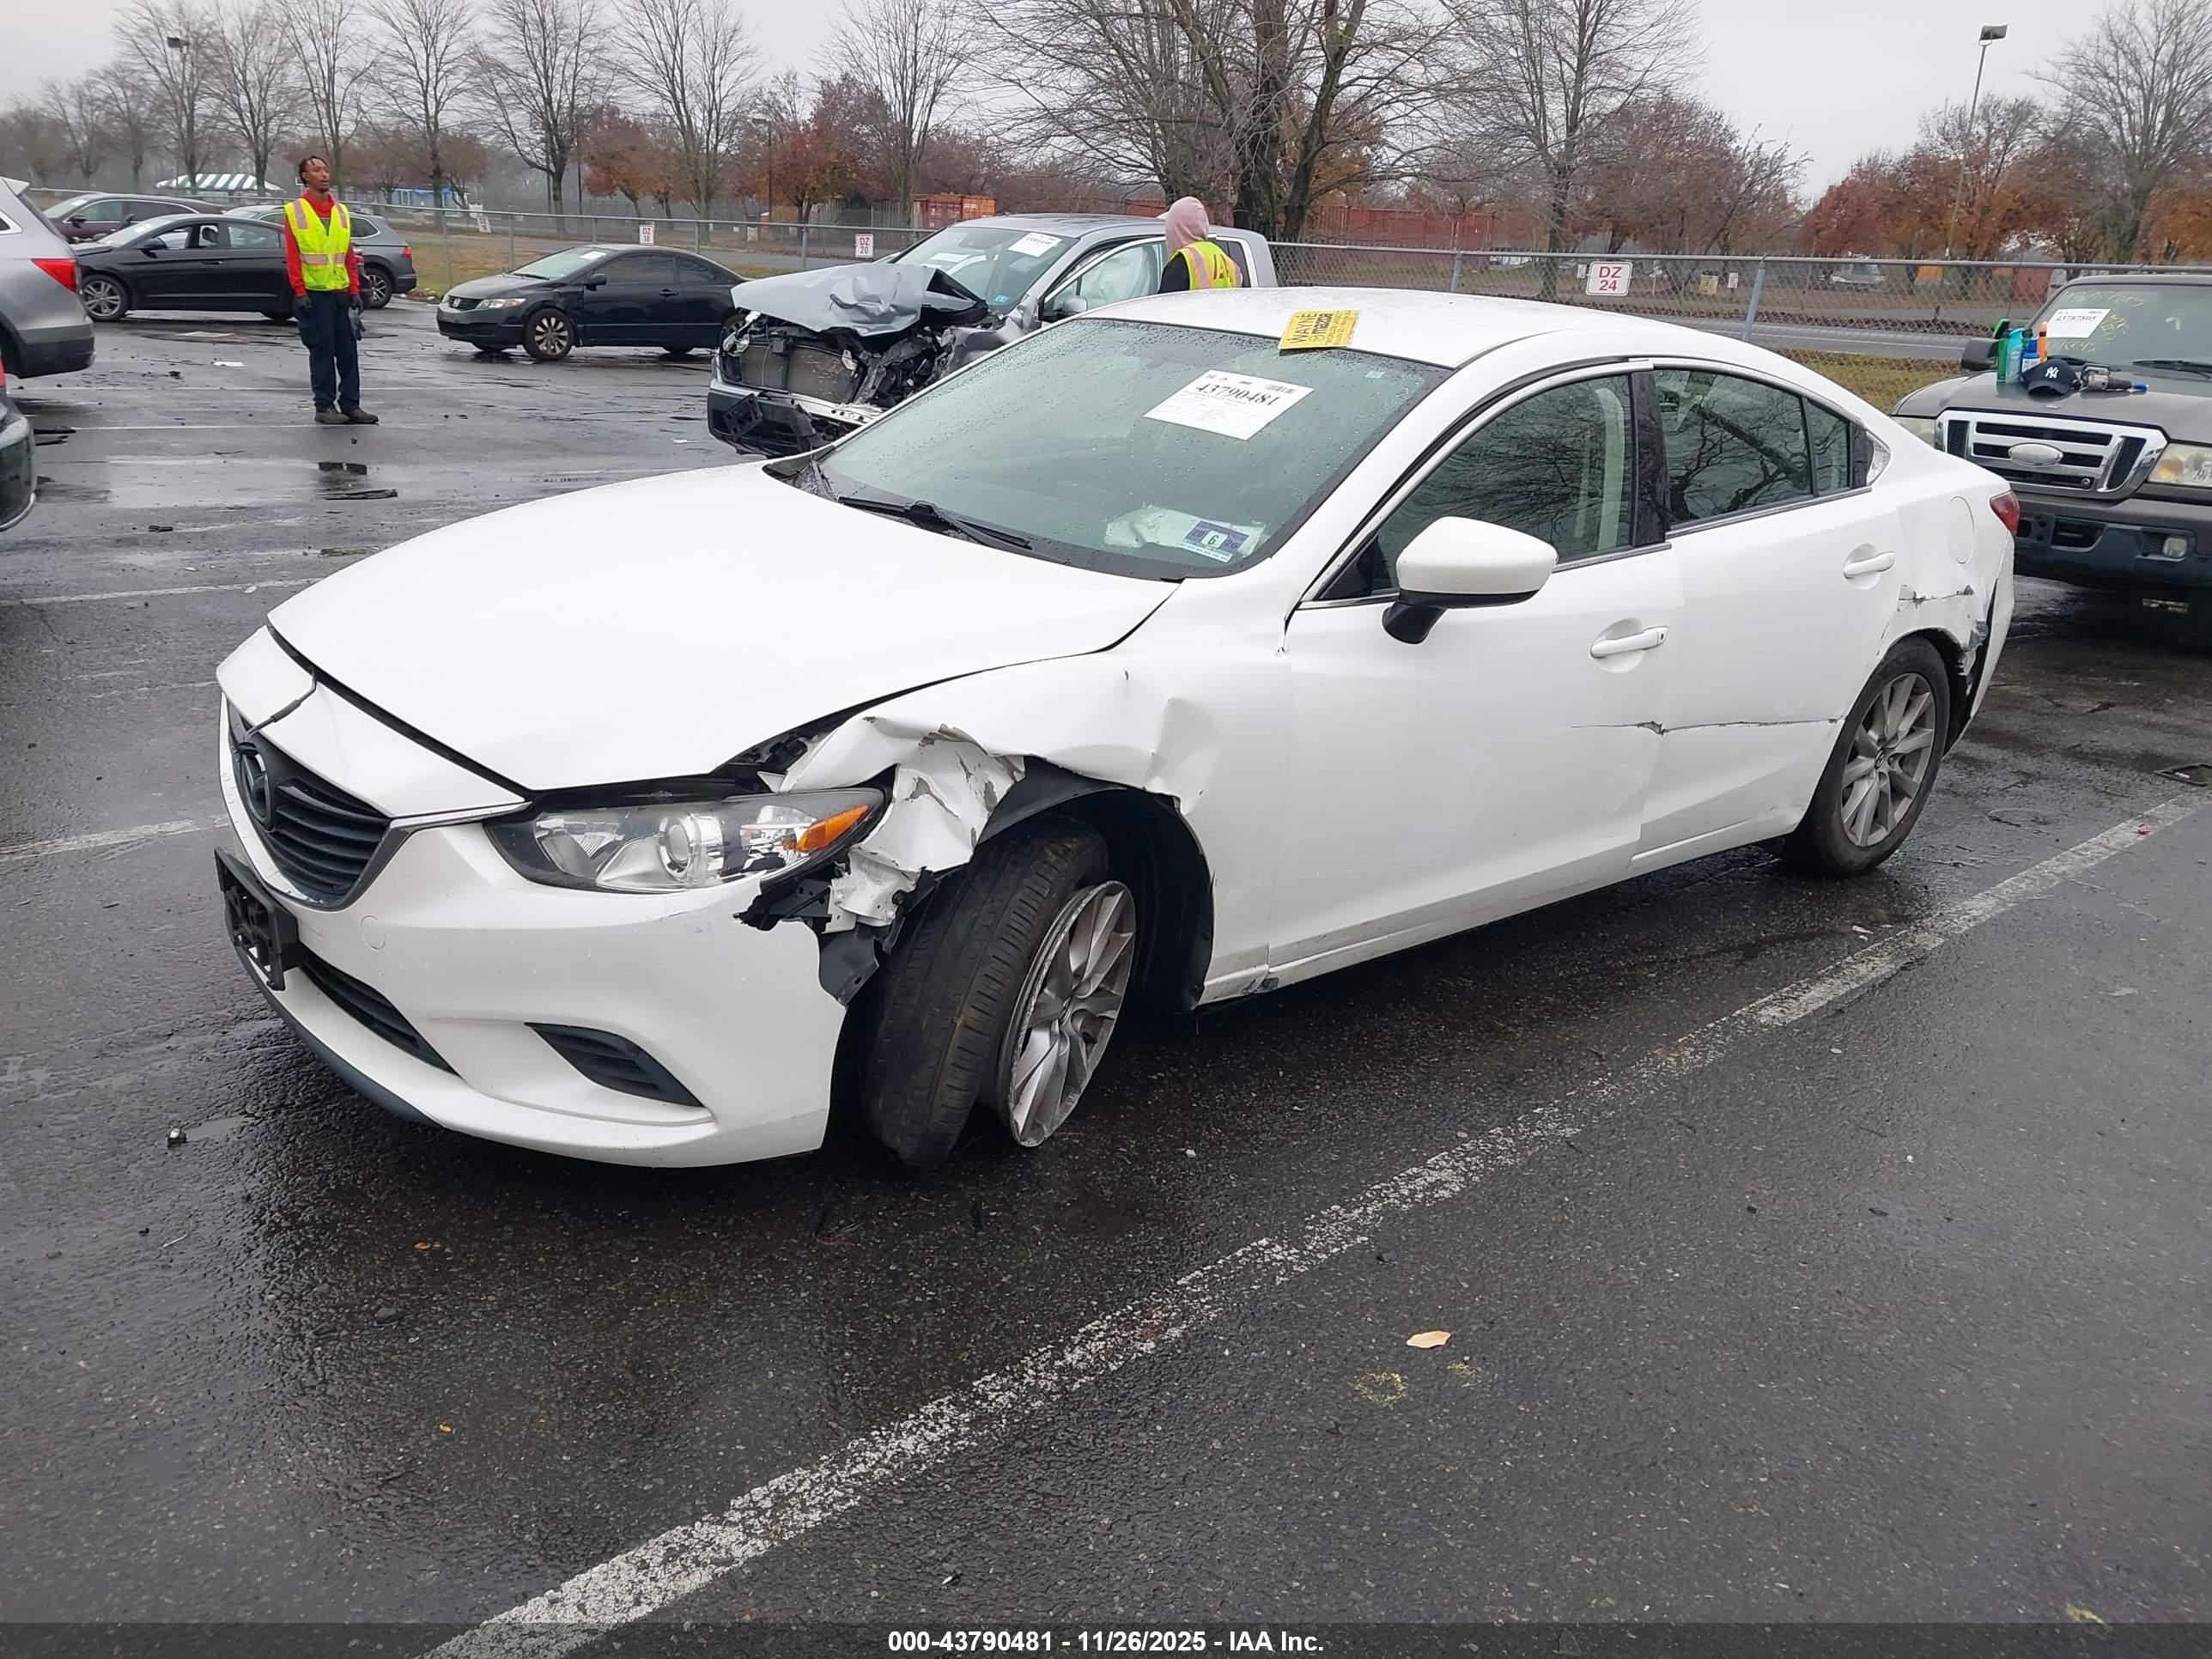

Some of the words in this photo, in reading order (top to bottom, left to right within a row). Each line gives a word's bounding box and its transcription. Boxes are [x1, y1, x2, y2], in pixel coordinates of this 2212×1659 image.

[860, 237, 870, 246] DZ
[860, 246, 868, 254] 20
[1599, 266, 1622, 278] DZ
[1599, 279, 1617, 291] 24
[1289, 313, 1316, 343] WAYNE
[1196, 382, 1280, 405] 43790481
[1207, 534, 1219, 545] 6
